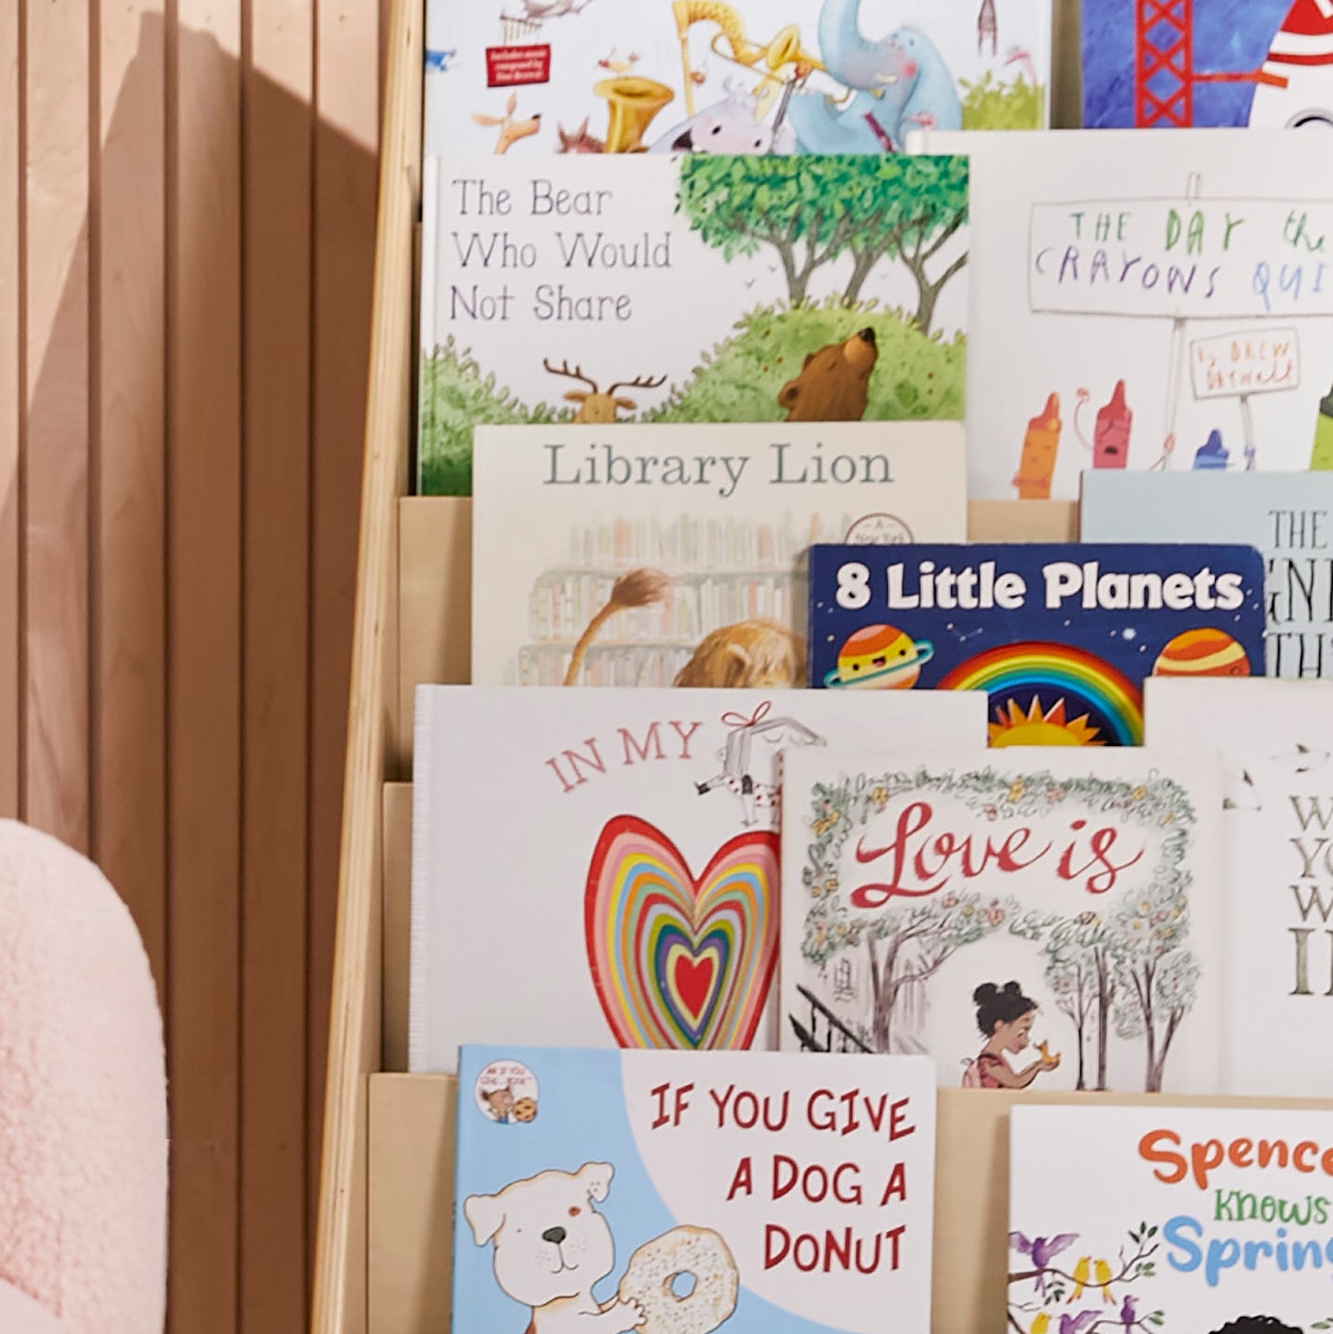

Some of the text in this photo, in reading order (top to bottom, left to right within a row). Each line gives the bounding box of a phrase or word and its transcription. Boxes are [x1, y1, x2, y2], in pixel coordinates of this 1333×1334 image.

[450, 178, 614, 216] The Bear
[450, 231, 673, 268] Who Would
[1069, 211, 1133, 243] THE
[1165, 208, 1245, 255] DAY
[1034, 245, 1222, 299] CRAYONS
[449, 283, 633, 320] Not Share
[541, 442, 895, 498] Library Lion
[1268, 510, 1328, 549] THE
[835, 561, 872, 610] 8
[886, 559, 1028, 610] Little
[1042, 560, 1245, 611] Planets
[544, 720, 704, 794] IN MY
[849, 801, 1147, 909] Love is
[650, 1082, 916, 1142] IF YOU GIVE
[726, 1154, 907, 1207] A DOG A
[762, 1223, 907, 1275] DONUT
